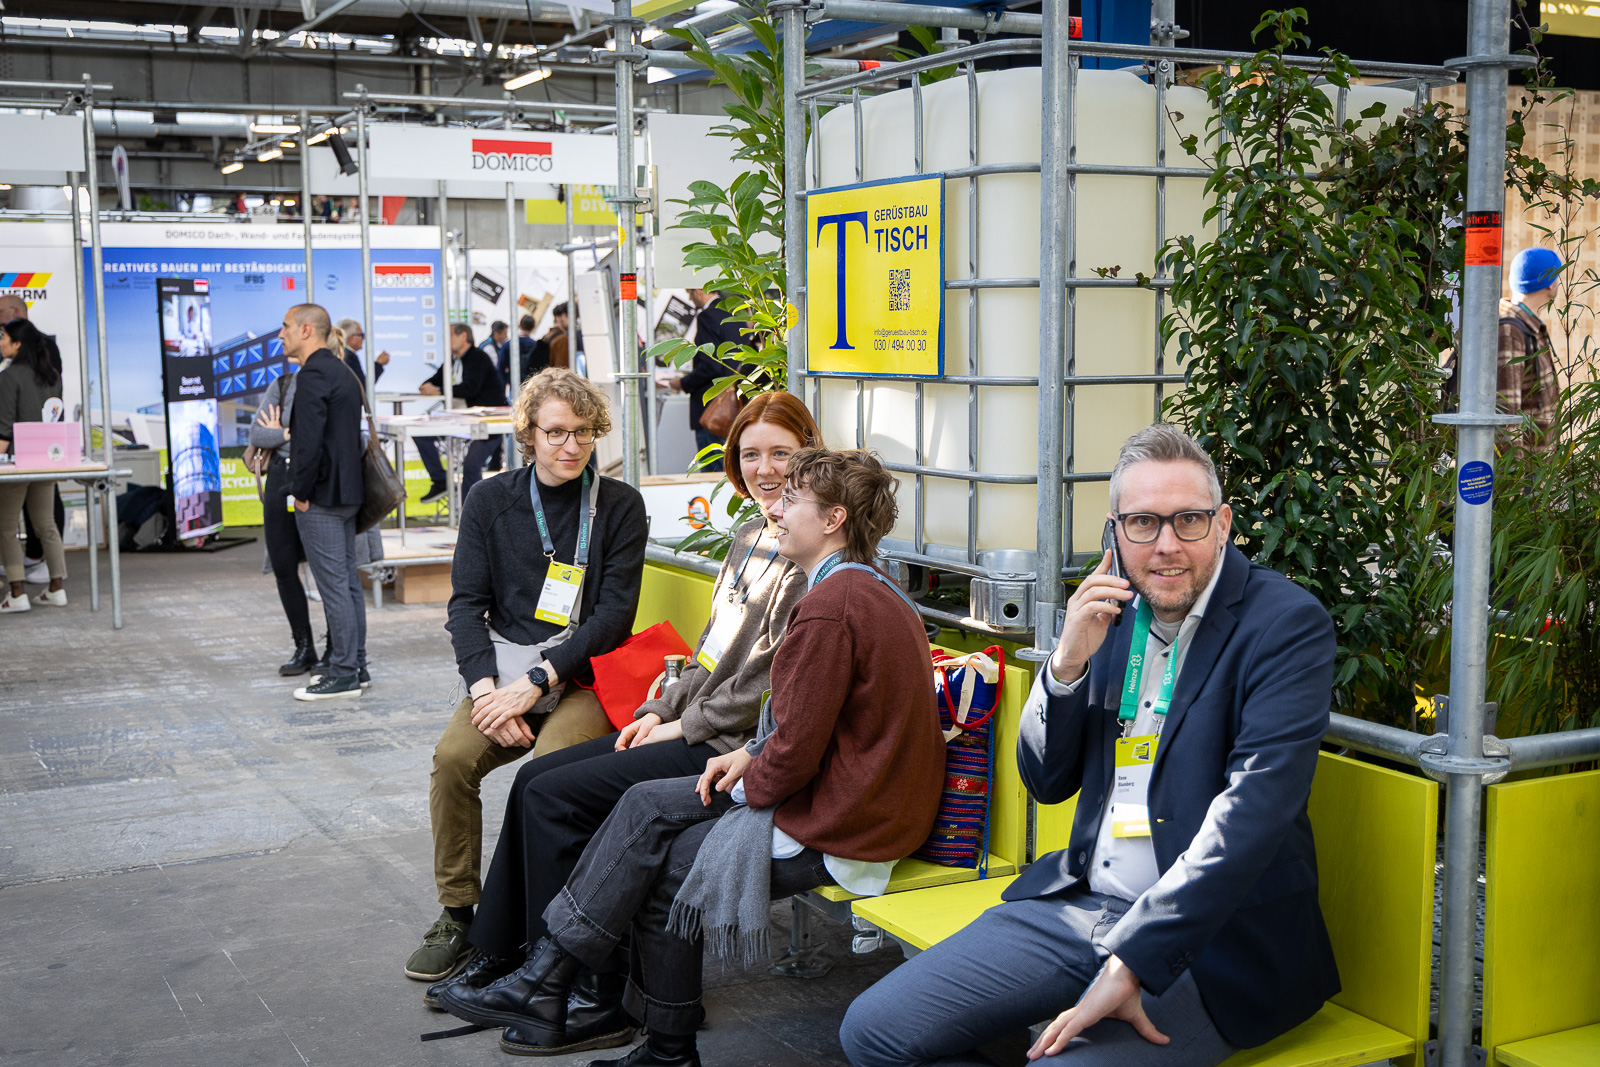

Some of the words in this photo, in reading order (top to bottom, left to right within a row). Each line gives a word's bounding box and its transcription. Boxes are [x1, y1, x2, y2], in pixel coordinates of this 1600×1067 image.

[472, 154, 553, 172] DOMICO
[874, 205, 928, 221] GERÜSTBAU
[165, 230, 205, 239] DOMICO
[874, 225, 928, 253] TISCH
[103, 263, 158, 273] REATIVES
[161, 263, 198, 273] BAUEN
[201, 263, 221, 273] MIT
[374, 276, 433, 287] DOMICO
[874, 328, 927, 337] info@geruestbau-tisch.de
[874, 339, 886, 351] 030
[891, 339, 904, 351] 494
[906, 340, 916, 351] 00
[917, 340, 927, 351] 30
[820, 556, 841, 576] Heinze
[1128, 668, 1138, 693] Heinze
